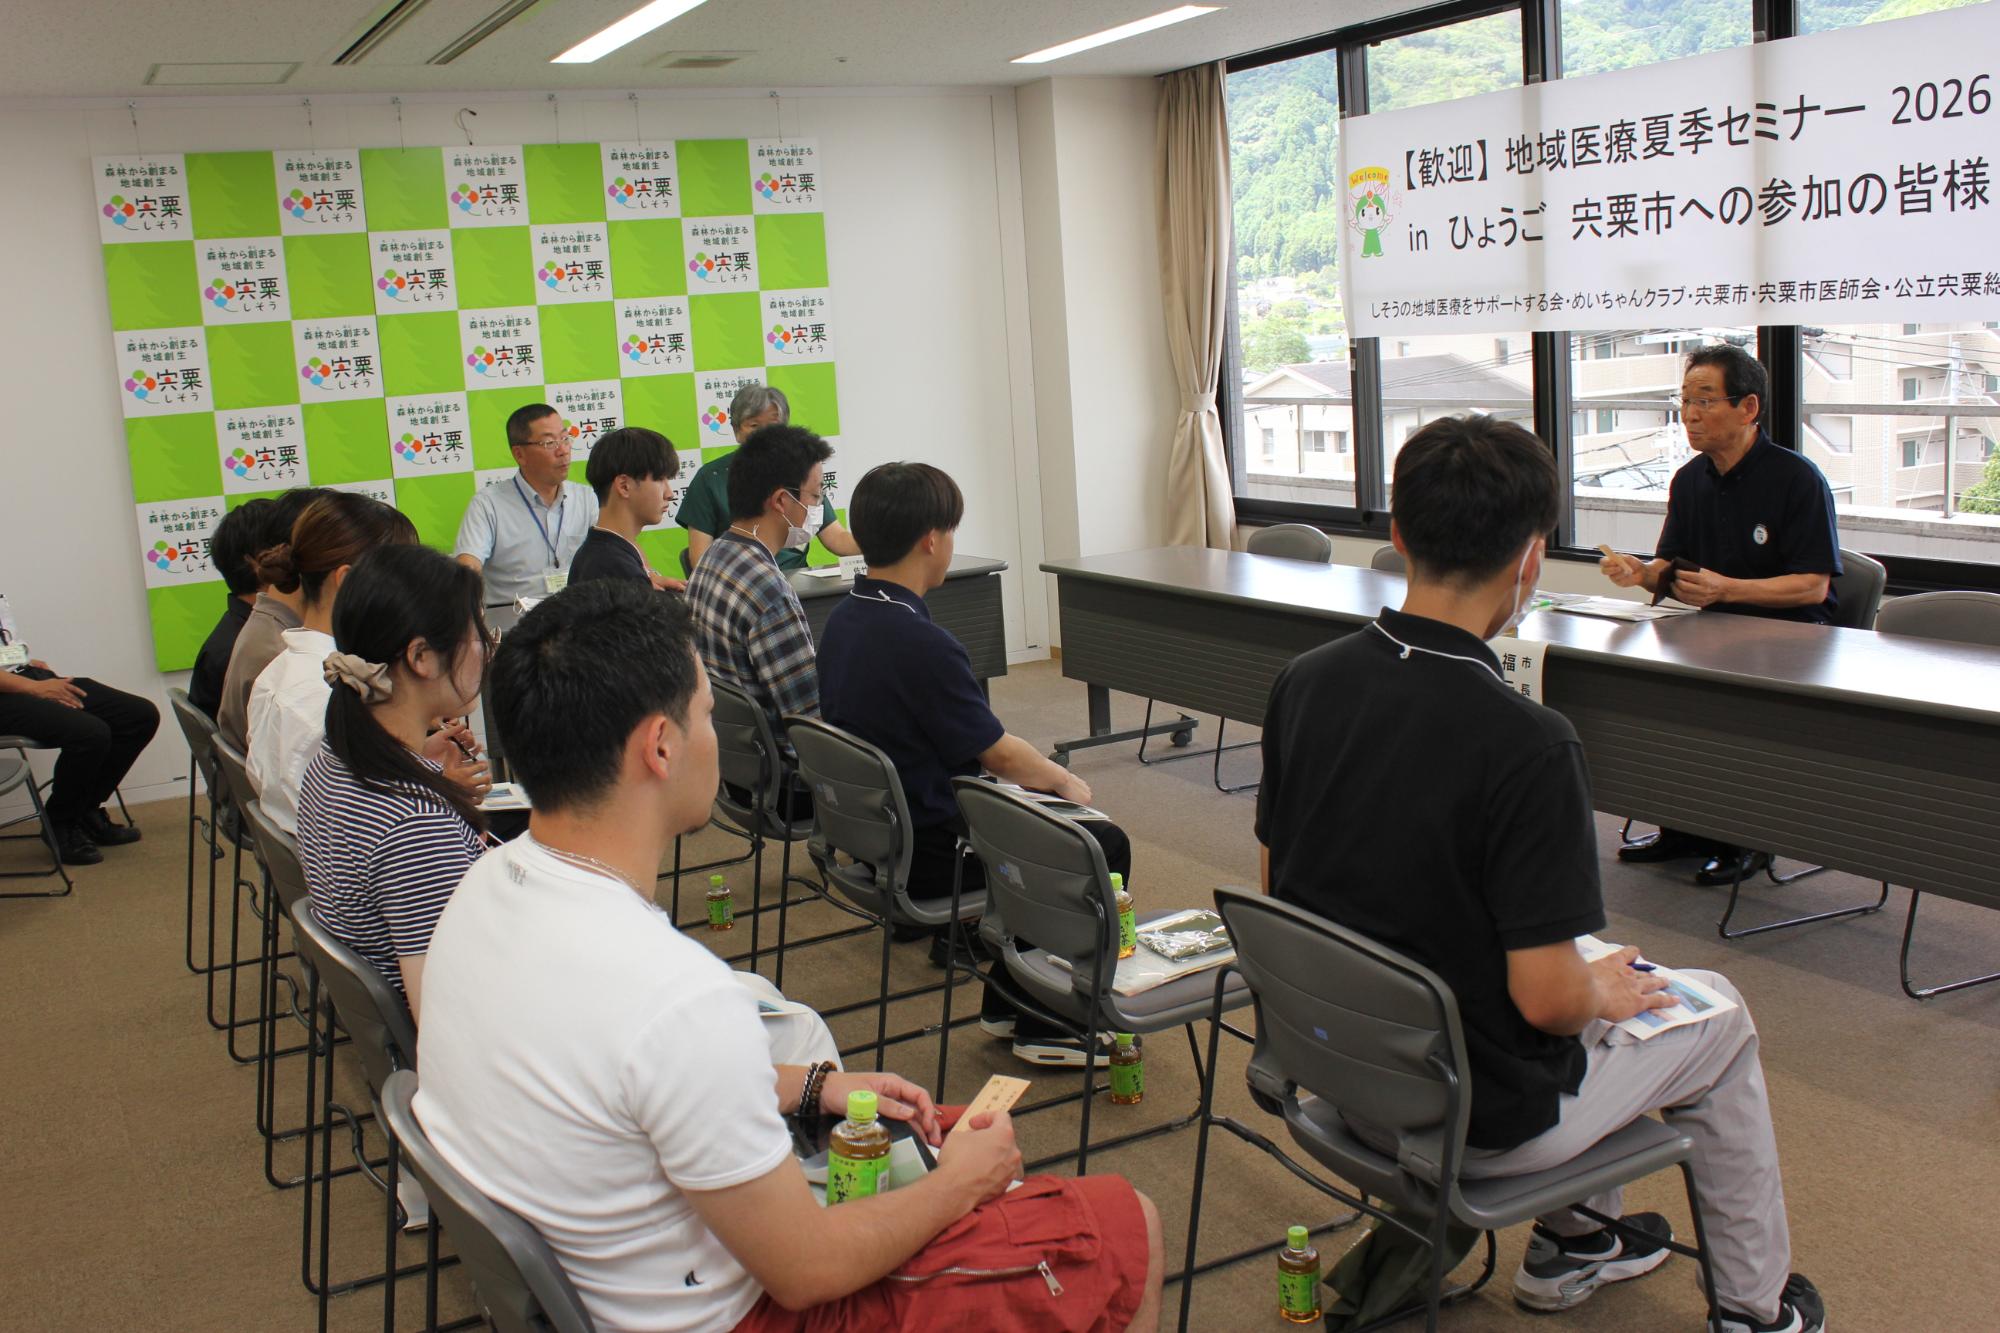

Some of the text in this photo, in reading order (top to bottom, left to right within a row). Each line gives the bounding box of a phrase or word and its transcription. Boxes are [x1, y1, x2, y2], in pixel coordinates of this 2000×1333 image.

[1891, 74, 1991, 125] 2026
[611, 150, 670, 161] 森林から創まる
[758, 148, 813, 157] 森林から創まる
[286, 161, 352, 172] 森林から創まる
[453, 157, 517, 167] 森林から創まる
[623, 161, 660, 170] 地域創生
[769, 157, 803, 166] 地域創生
[105, 166, 178, 176] 森林から創まる
[467, 166, 506, 176] 地域創生
[299, 172, 341, 182] 地域創生
[780, 173, 815, 192] 宍粟
[121, 178, 166, 188] 地域創生
[635, 177, 672, 198] 宍粟
[479, 184, 520, 205] 宍粟
[785, 195, 815, 203] しそう
[135, 195, 182, 218] 宍粟
[313, 190, 356, 212] 宍粟
[640, 200, 670, 209] しそう
[1409, 158, 1990, 251] in ひょうご 宍粟市への参加の皆様
[486, 206, 517, 216] しそう
[321, 213, 353, 222] しそう
[143, 221, 178, 230] しそう
[692, 226, 749, 236] 森林から創まる
[541, 233, 602, 244] 森林から創まる
[703, 236, 739, 245] 地域創生
[380, 241, 444, 252] 森林から創まる
[553, 244, 591, 253] 地域創生
[207, 249, 276, 260] 森林から創まる
[393, 252, 433, 262] 地域創生
[221, 261, 264, 271] 地域創生
[715, 252, 752, 272] 宍粟
[566, 261, 604, 281] 宍粟
[406, 268, 448, 290] 宍粟
[720, 273, 749, 282] しそう
[236, 278, 280, 300] 宍粟
[572, 283, 601, 292] しそう
[413, 292, 445, 301] しそう
[243, 302, 277, 312] しそう
[770, 298, 824, 308] 森林から創まる
[624, 307, 682, 318] 森林から創まる
[781, 308, 816, 317] 地域創生
[469, 318, 532, 329] 森林から創まる
[636, 317, 673, 327] 地域創生
[304, 328, 370, 340] 森林から創まる
[482, 328, 522, 338] 地域創生
[792, 323, 827, 343] 宍粟
[127, 339, 198, 352] 森林から創まる
[318, 339, 359, 350] 地域創生
[648, 333, 686, 354] 宍粟
[495, 344, 535, 366] 宍粟
[797, 345, 824, 354] しそう
[142, 351, 187, 362] 地域創生
[654, 355, 682, 365] しそう
[331, 356, 375, 378] 宍粟
[501, 367, 532, 377] しそう
[157, 368, 202, 391] 宍粟
[338, 379, 371, 389] しそう
[164, 393, 199, 403] しそう
[556, 390, 615, 402] 森林から創まる
[397, 404, 461, 416] 森林から創まる
[568, 402, 606, 412] 地域創生
[227, 417, 296, 430] 森林から創まる
[410, 415, 450, 425] 地域創生
[241, 429, 285, 440] 地域創生
[423, 431, 464, 453] 宍粟
[255, 445, 299, 469] 宍粟
[430, 454, 461, 464] しそう
[263, 469, 296, 480] しそう
[149, 508, 218, 523] 森林から創まる
[163, 521, 208, 532] 地域創生
[186, 562, 207, 573] しそ
[1521, 656, 1532, 697] 市長
